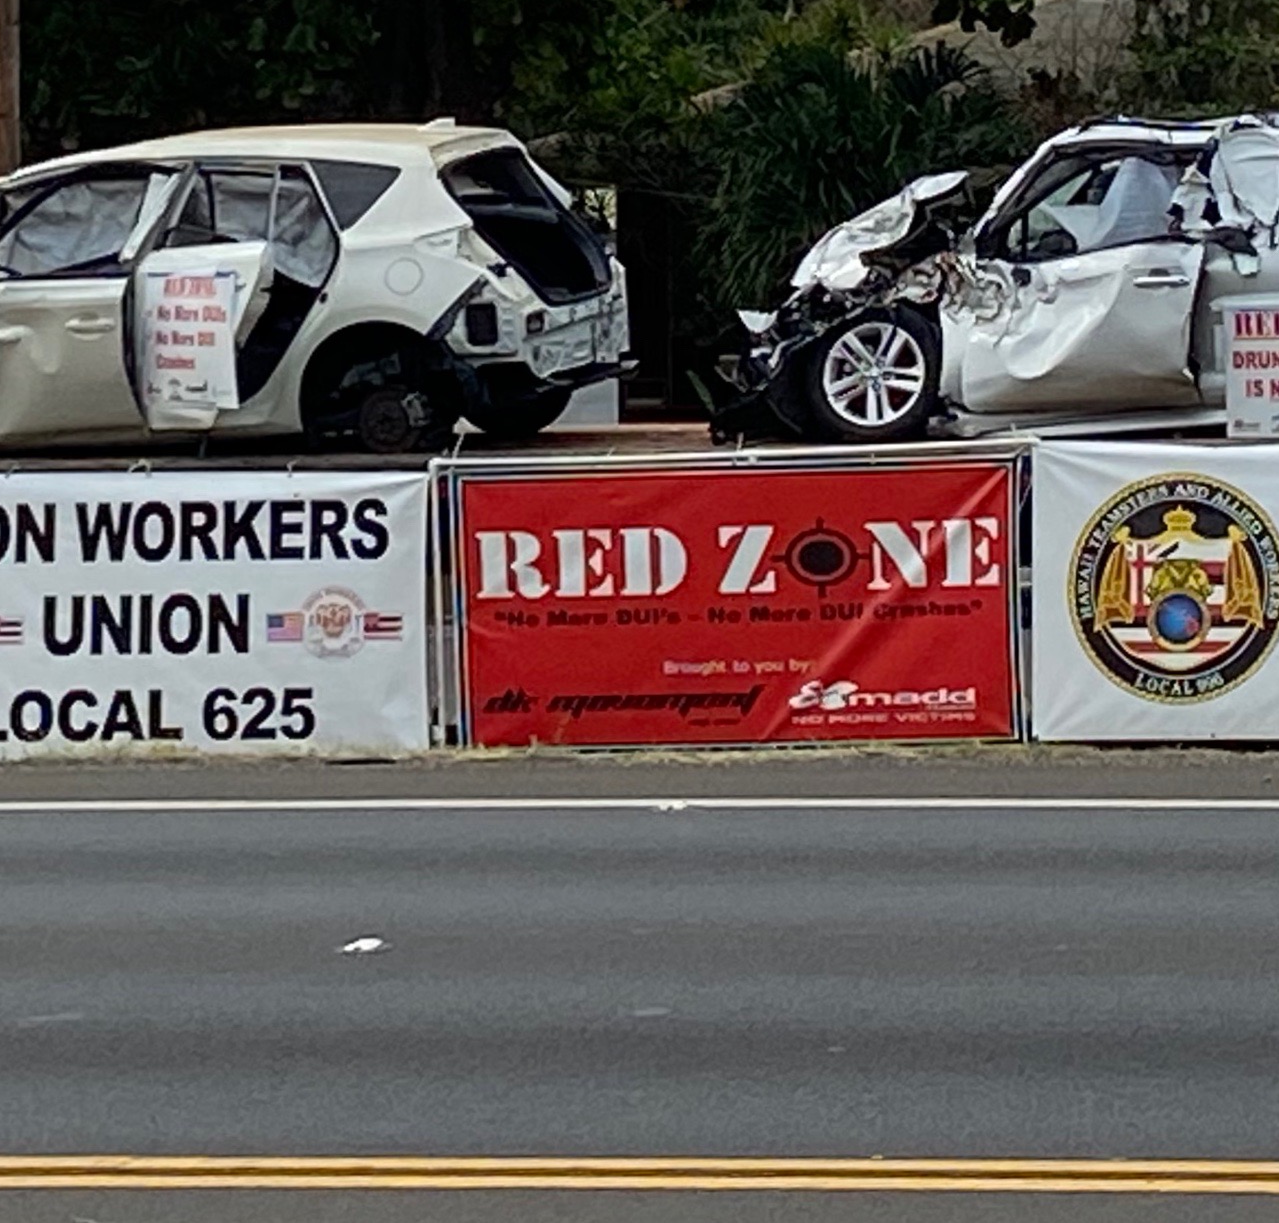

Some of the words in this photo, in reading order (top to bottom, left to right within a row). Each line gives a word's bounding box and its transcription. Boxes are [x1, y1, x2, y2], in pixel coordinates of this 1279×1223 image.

[1245, 379, 1264, 397] IS
[76, 498, 389, 562] WORKERS
[475, 526, 688, 599] RED
[1078, 552, 1096, 620] HAWAII
[1087, 484, 1168, 548] TEAMSTERS
[1173, 483, 1210, 498] AND
[1211, 489, 1264, 535] ALLIED
[43, 592, 250, 656] UNION
[708, 606, 742, 623] No
[749, 606, 812, 623] More
[820, 602, 864, 621] DUI
[664, 660, 726, 676] Brought
[732, 659, 751, 673] to
[754, 661, 784, 674] you
[1135, 672, 1194, 695] LOCAL
[848, 686, 977, 708] madd
[203, 687, 316, 741] 625
[792, 713, 823, 725] NO
[829, 712, 889, 724] MORE
[893, 711, 976, 724] VICTIMS
